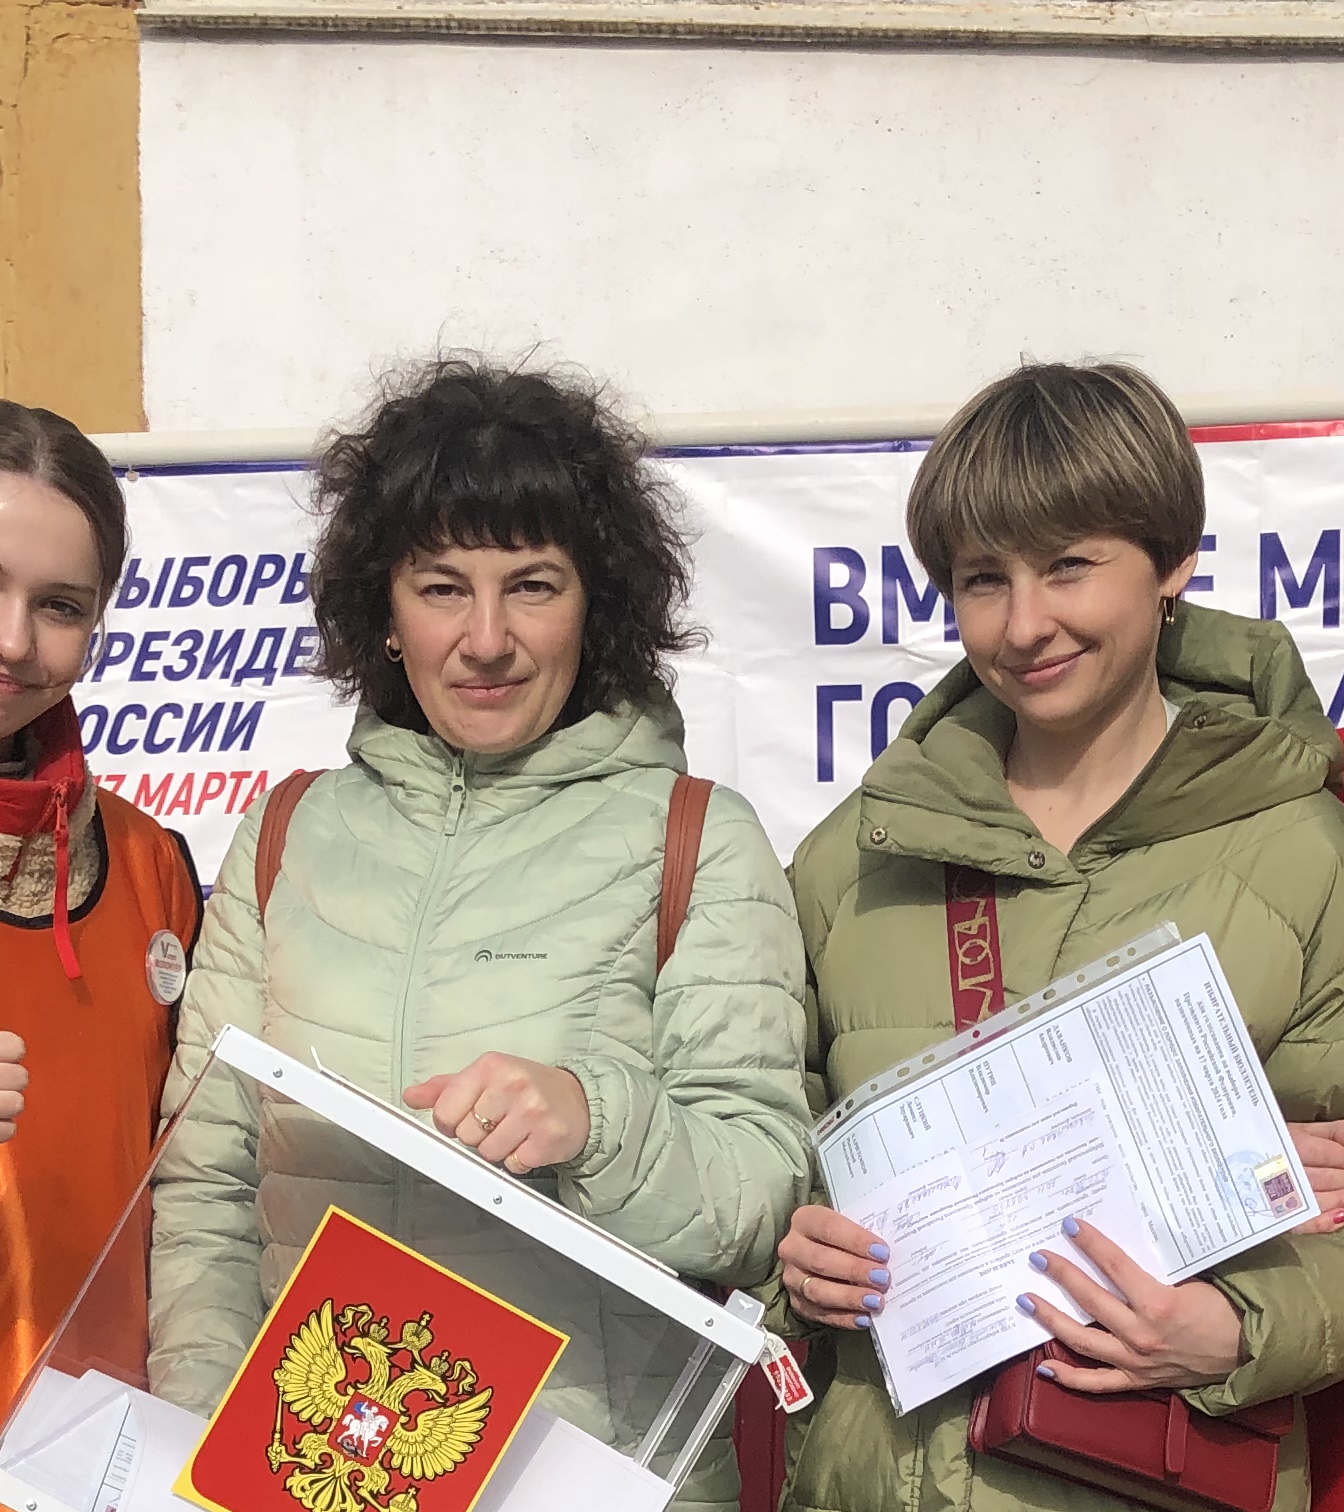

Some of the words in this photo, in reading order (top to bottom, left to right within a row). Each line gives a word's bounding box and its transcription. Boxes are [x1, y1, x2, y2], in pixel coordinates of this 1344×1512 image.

[114, 553, 315, 610] ЫБОРЫ
[78, 700, 266, 755] ОССИИ
[133, 770, 269, 817] МАРТА
[495, 952, 548, 960] OUTVENTURE
[1201, 981, 1240, 1054] ИЗБИРАТЕЛЬНЫЙ
[1231, 1053, 1261, 1107] БЮЛЛЕТЕНЬ
[1210, 1085, 1222, 1103] 2024
